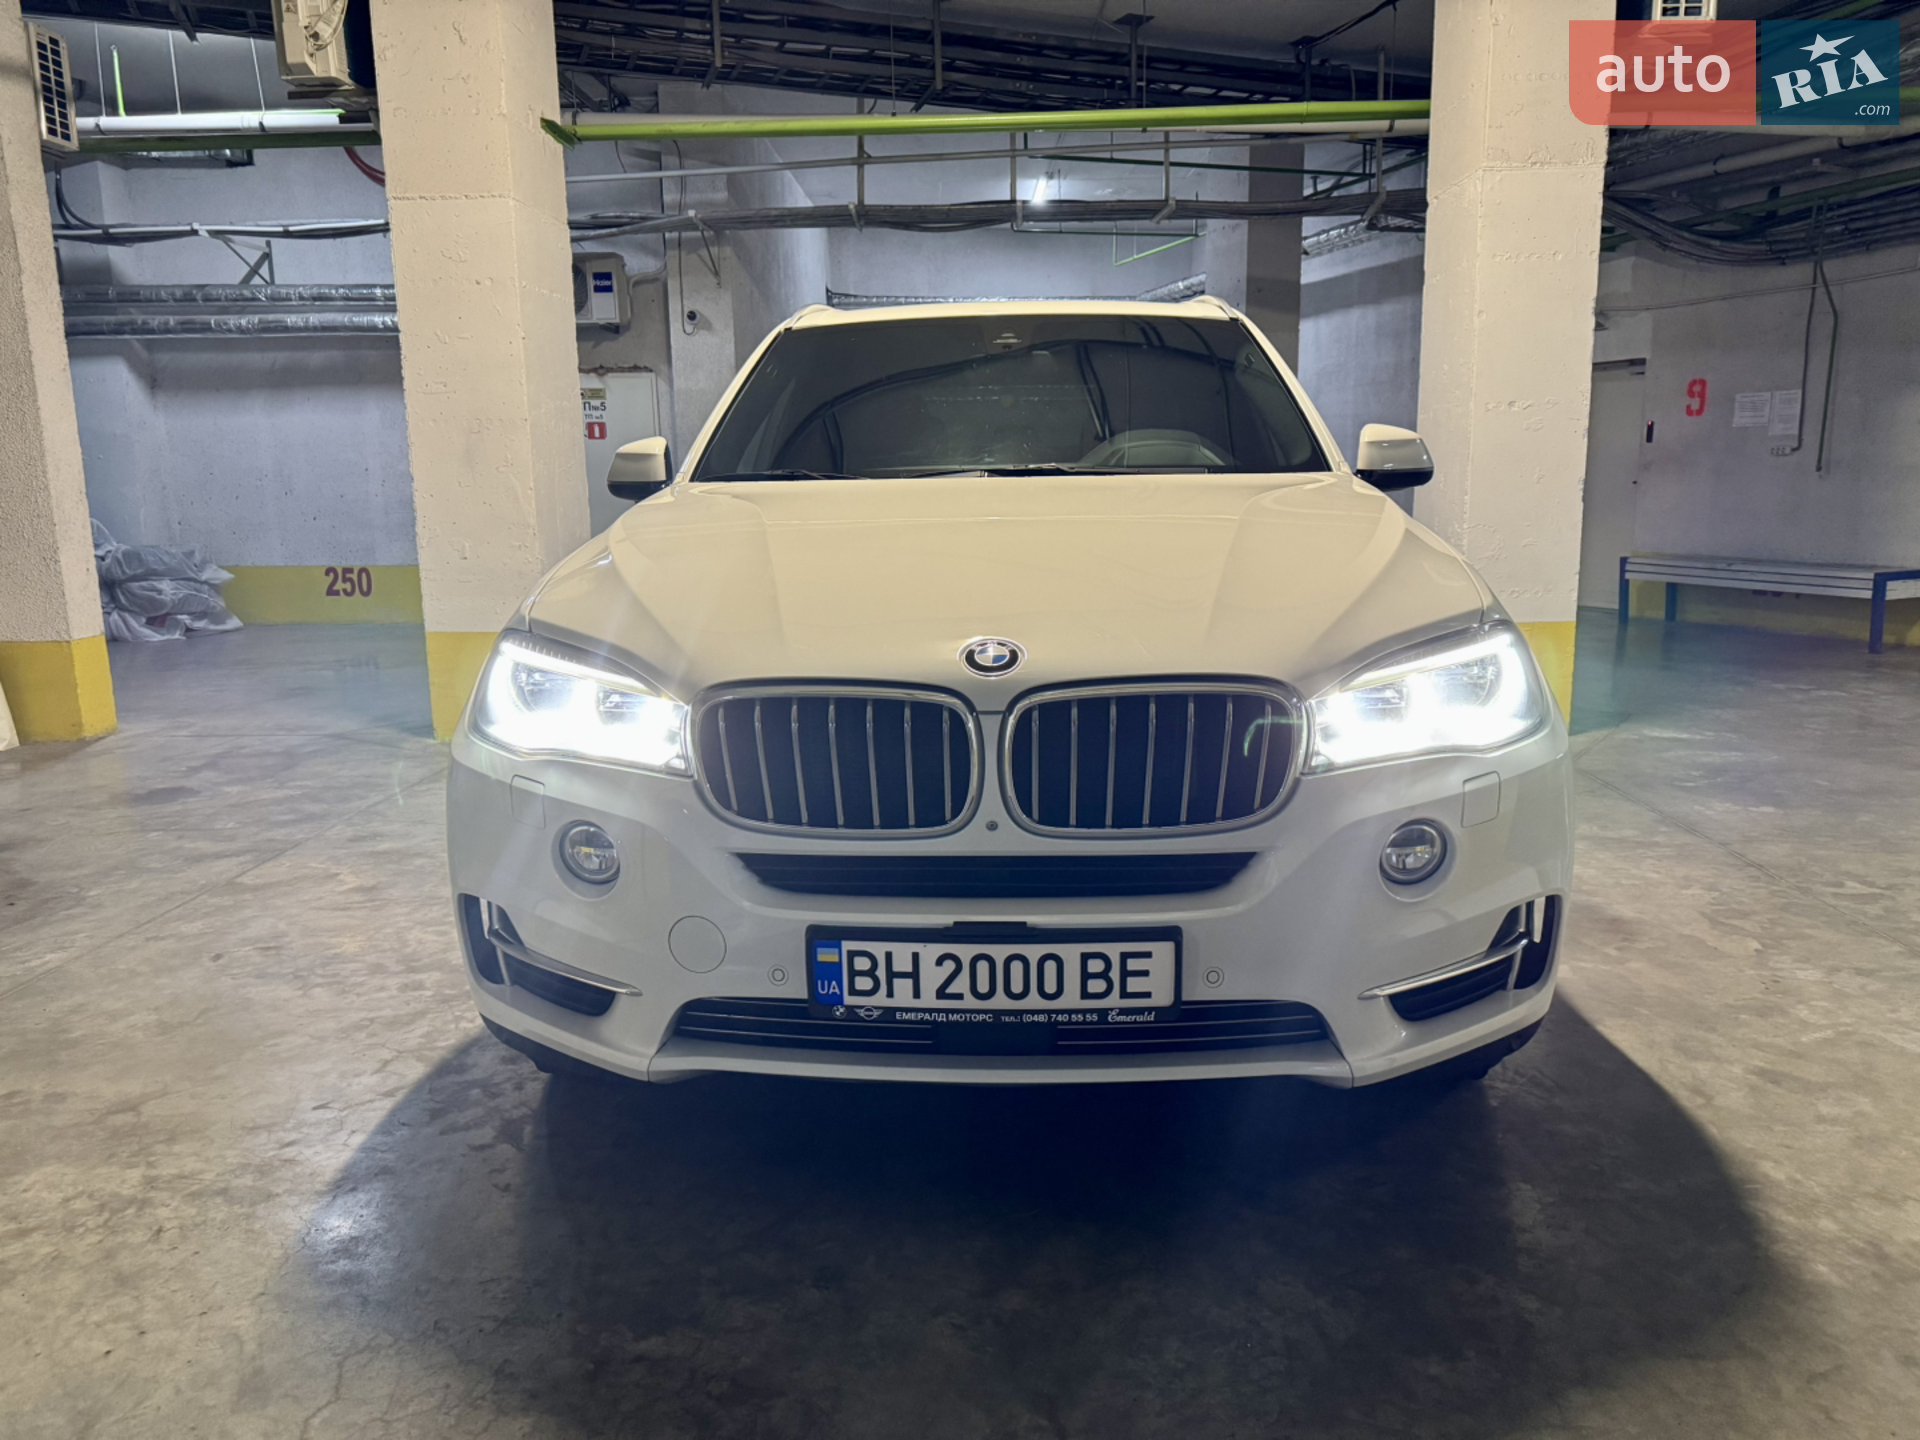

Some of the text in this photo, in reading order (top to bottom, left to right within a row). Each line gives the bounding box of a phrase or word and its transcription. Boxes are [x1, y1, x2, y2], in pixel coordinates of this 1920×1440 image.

[1685, 378, 1707, 417] 9
[583, 401, 607, 412] П№5
[324, 566, 373, 598] 250
[846, 949, 1153, 1001] BH 2000 BE
[817, 980, 841, 995] UA
[895, 1011, 994, 1022] ЕМЕРАЛД МОТОРС
[1022, 1013, 1048, 1023] (048)
[1051, 1014, 1069, 1022] 740
[1071, 1014, 1084, 1022] 55
[1086, 1014, 1098, 1022] 55
[1107, 1009, 1155, 1022] Emerald
